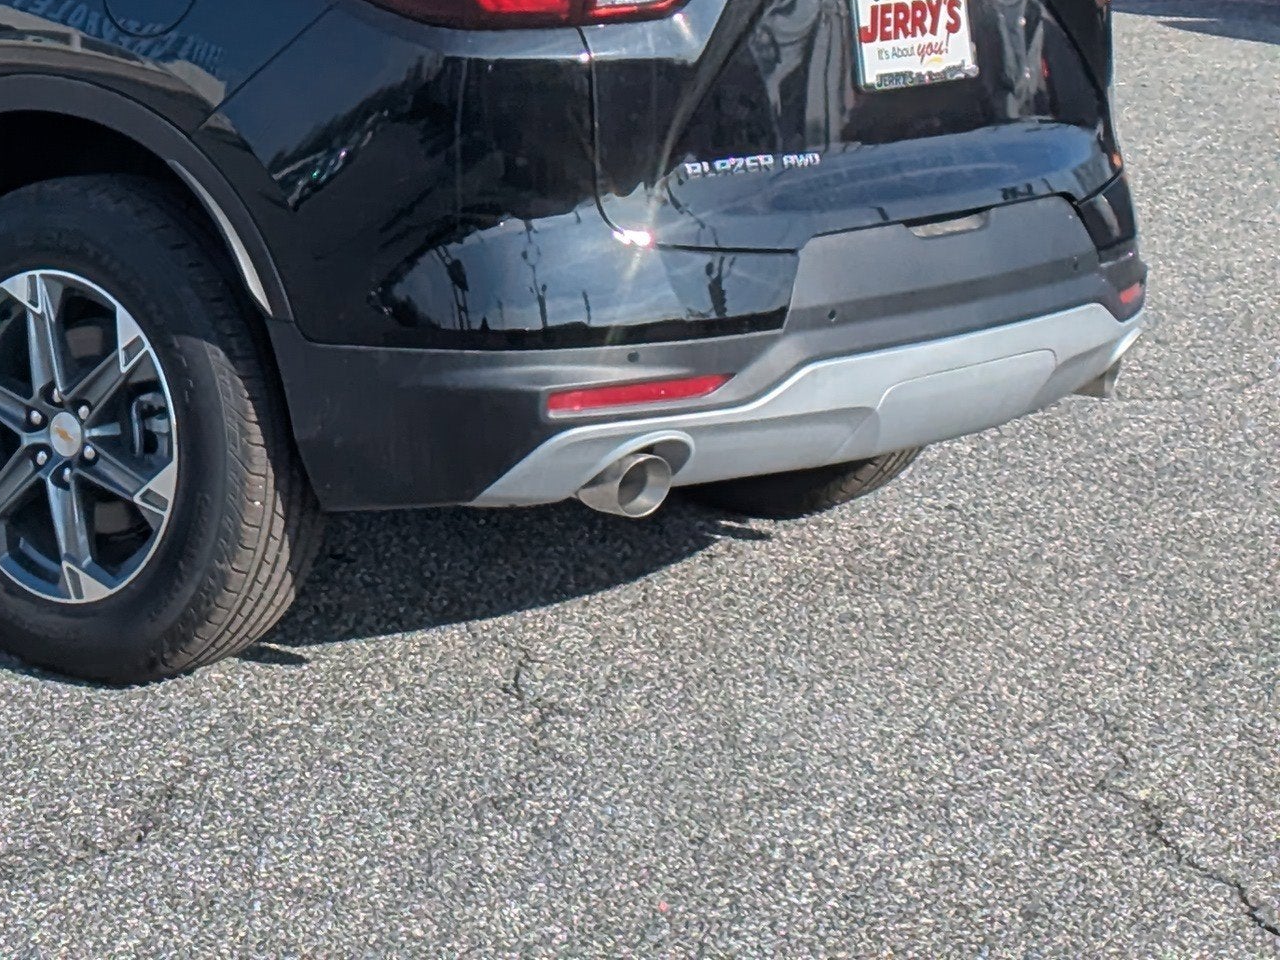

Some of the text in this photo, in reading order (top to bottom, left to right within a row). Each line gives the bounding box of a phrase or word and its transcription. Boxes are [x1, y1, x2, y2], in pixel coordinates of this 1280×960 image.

[891, 44, 916, 59] About
[684, 152, 821, 178] BLAZER AWD
